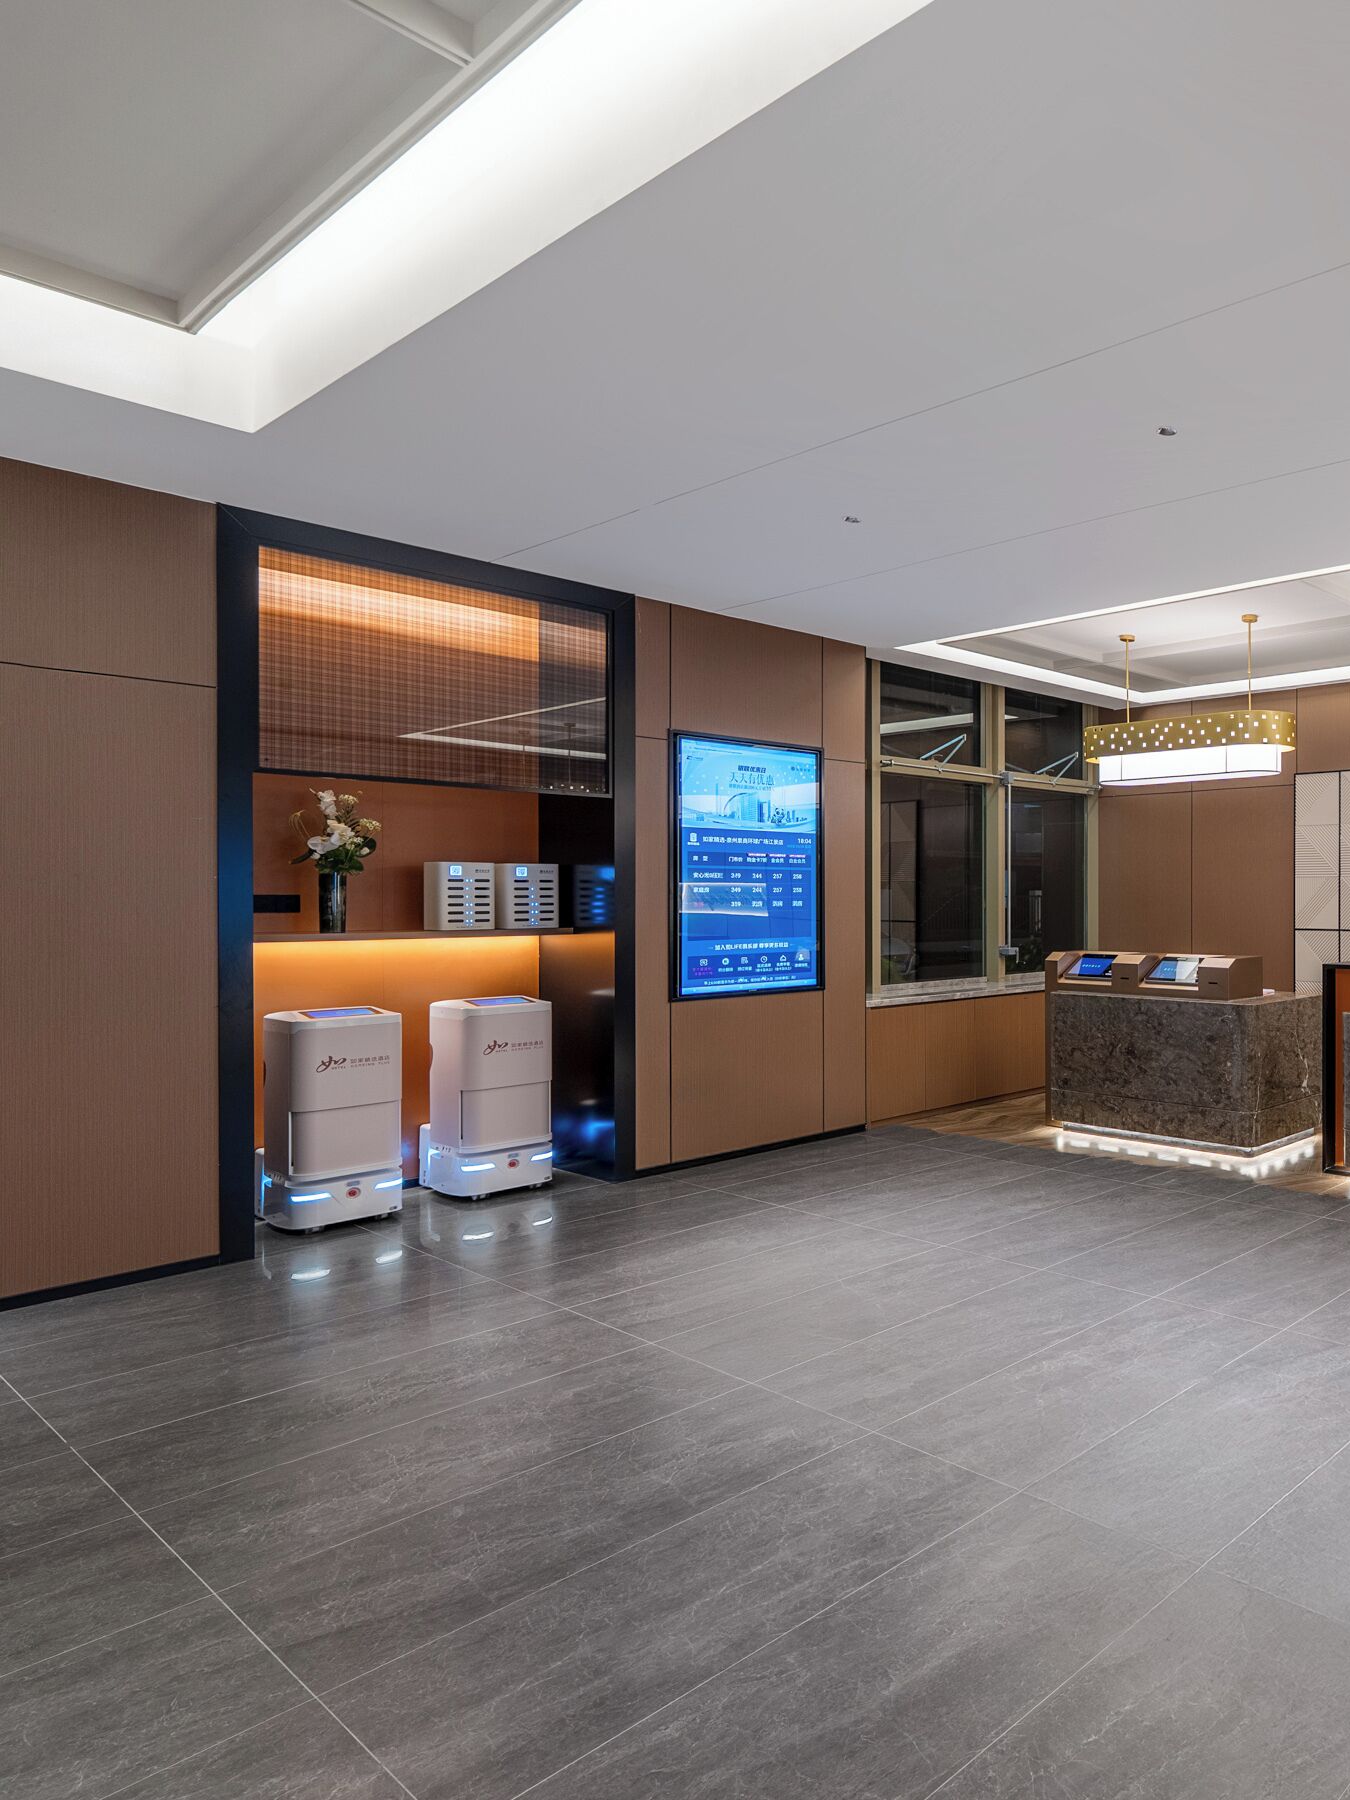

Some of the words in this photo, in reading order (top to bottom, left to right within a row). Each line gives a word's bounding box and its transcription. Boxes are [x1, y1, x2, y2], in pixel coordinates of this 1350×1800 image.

[729, 772, 774, 786] 天天有优惠
[350, 1055, 390, 1064] 如家精选酒店
